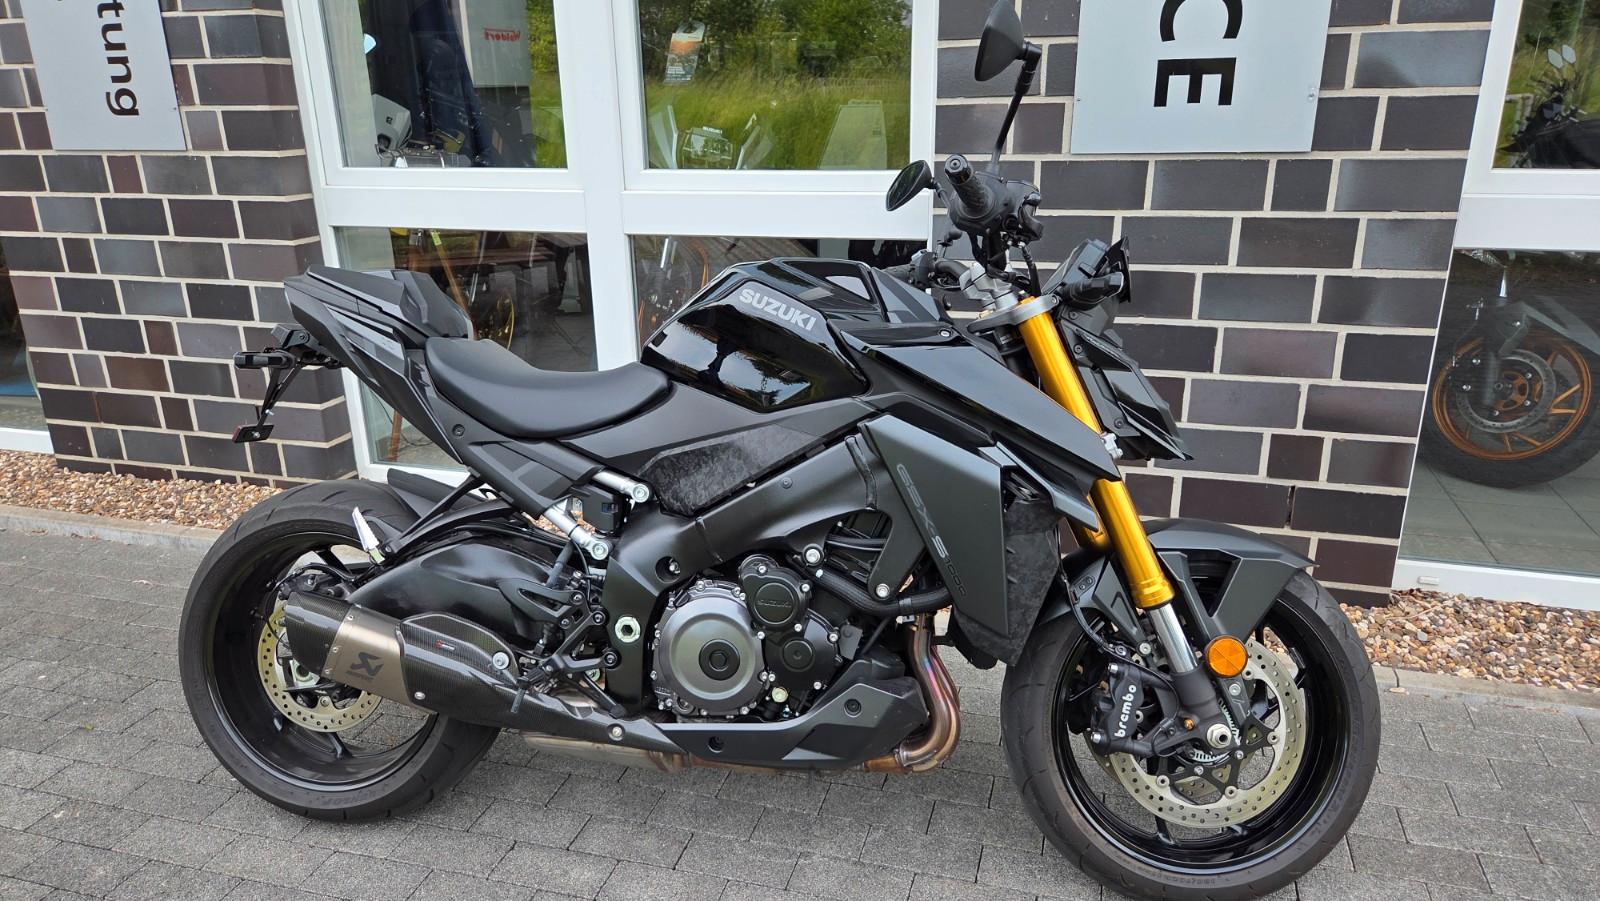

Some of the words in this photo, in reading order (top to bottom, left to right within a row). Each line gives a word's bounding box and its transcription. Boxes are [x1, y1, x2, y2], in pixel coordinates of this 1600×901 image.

[1154, 0, 1243, 107] CE
[739, 288, 817, 331] SUZUKI
[1114, 684, 1137, 738] brembo
